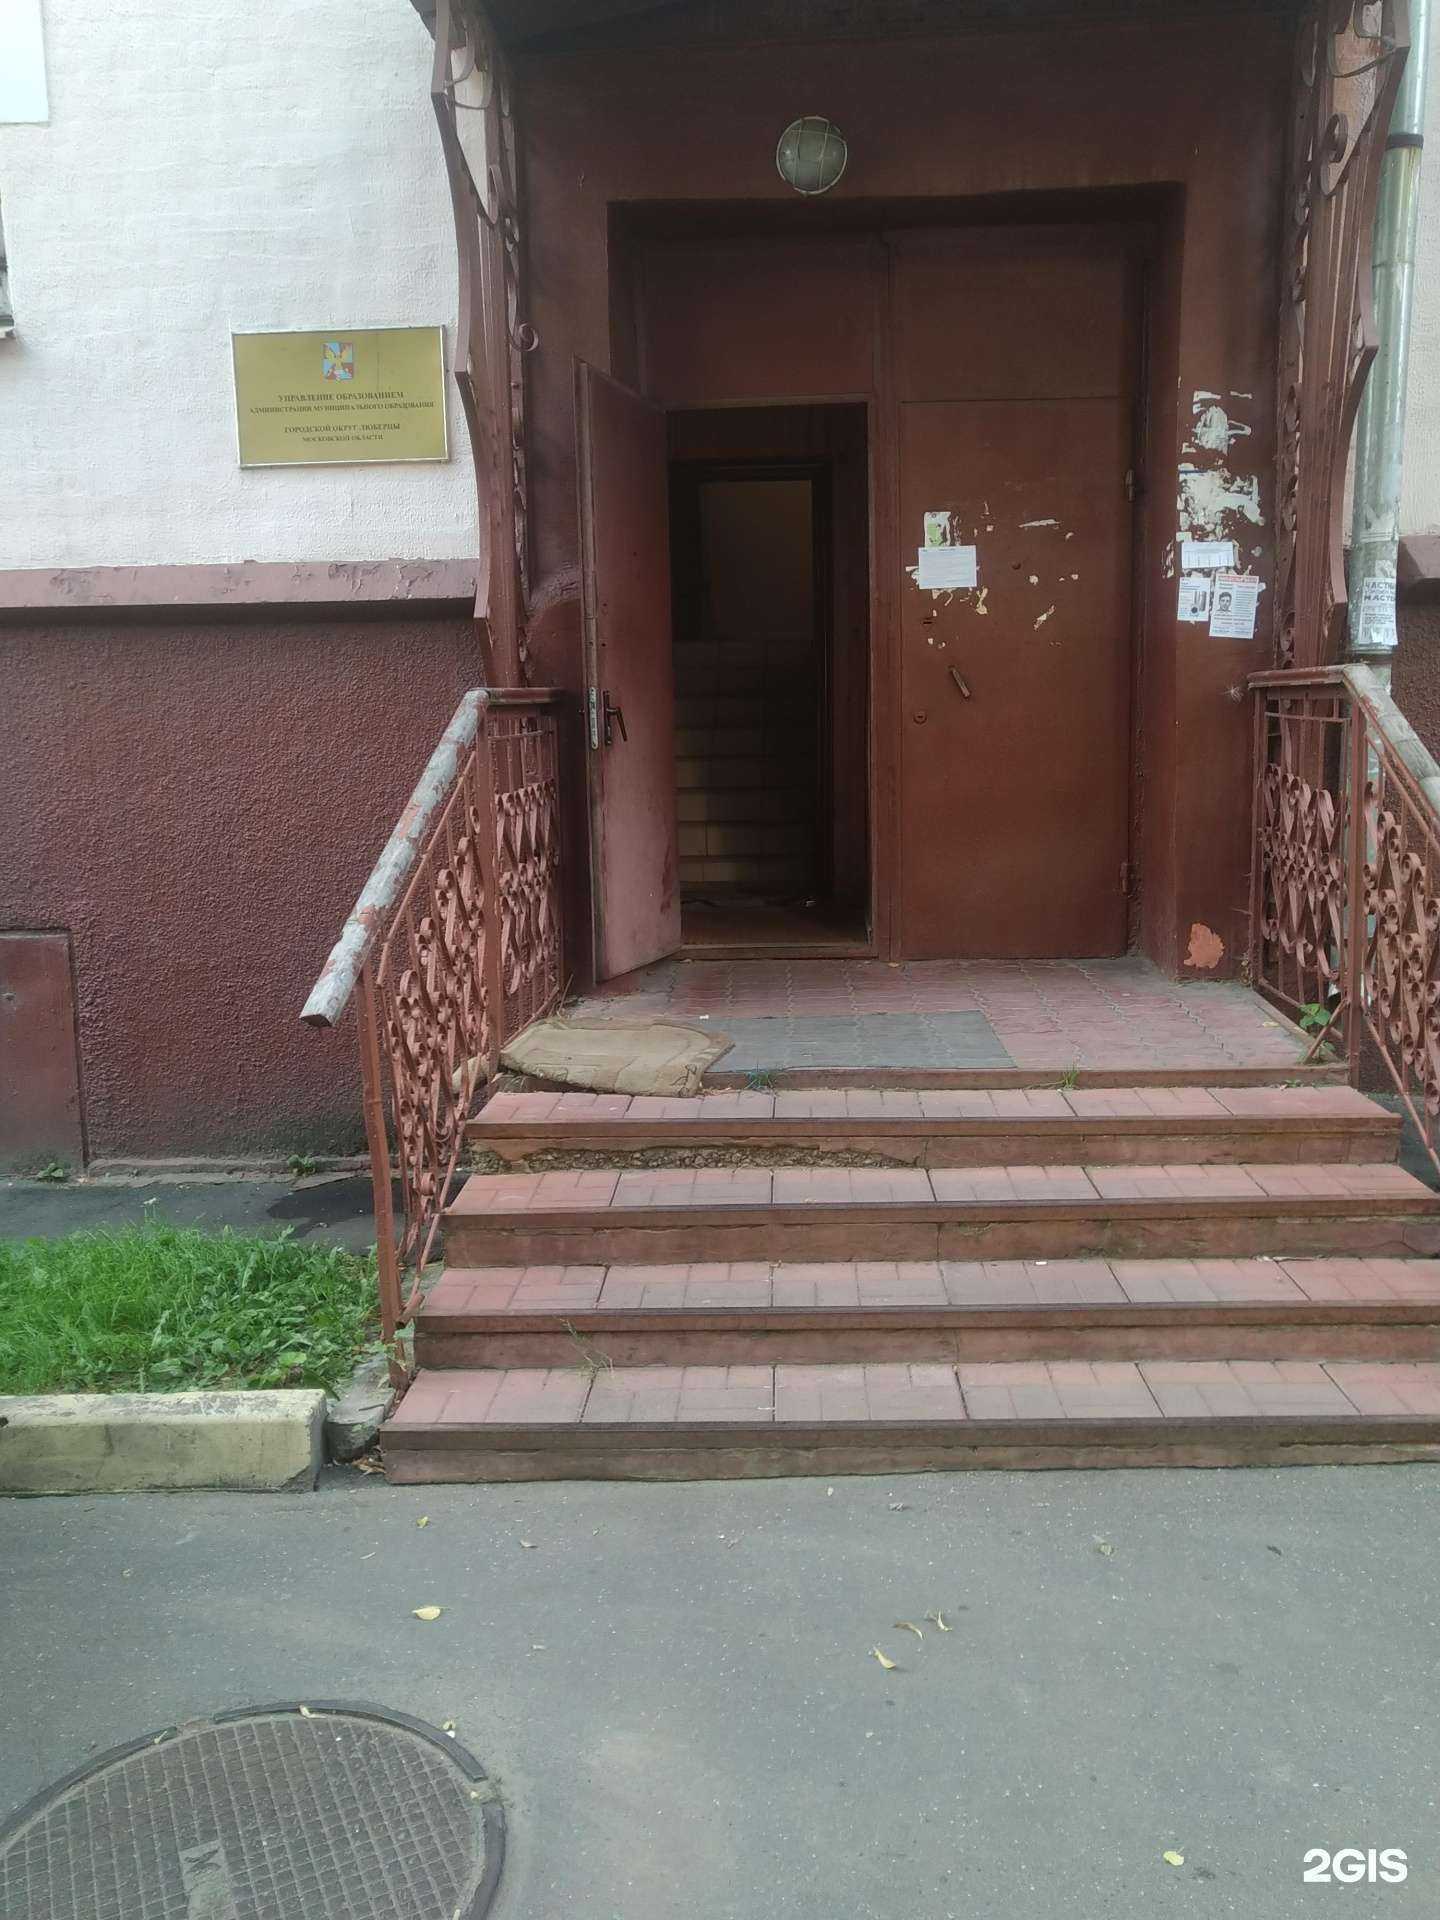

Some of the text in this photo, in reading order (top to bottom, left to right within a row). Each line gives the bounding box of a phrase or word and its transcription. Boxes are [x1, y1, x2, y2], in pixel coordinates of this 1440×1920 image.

[278, 391, 404, 402] УПРАВЛЕНИЕ ОБРАЗОВАНИЕМ
[284, 424, 332, 432] ГОРОДСКОЙ
[360, 423, 400, 431] ЛЮБЕРЦЫ
